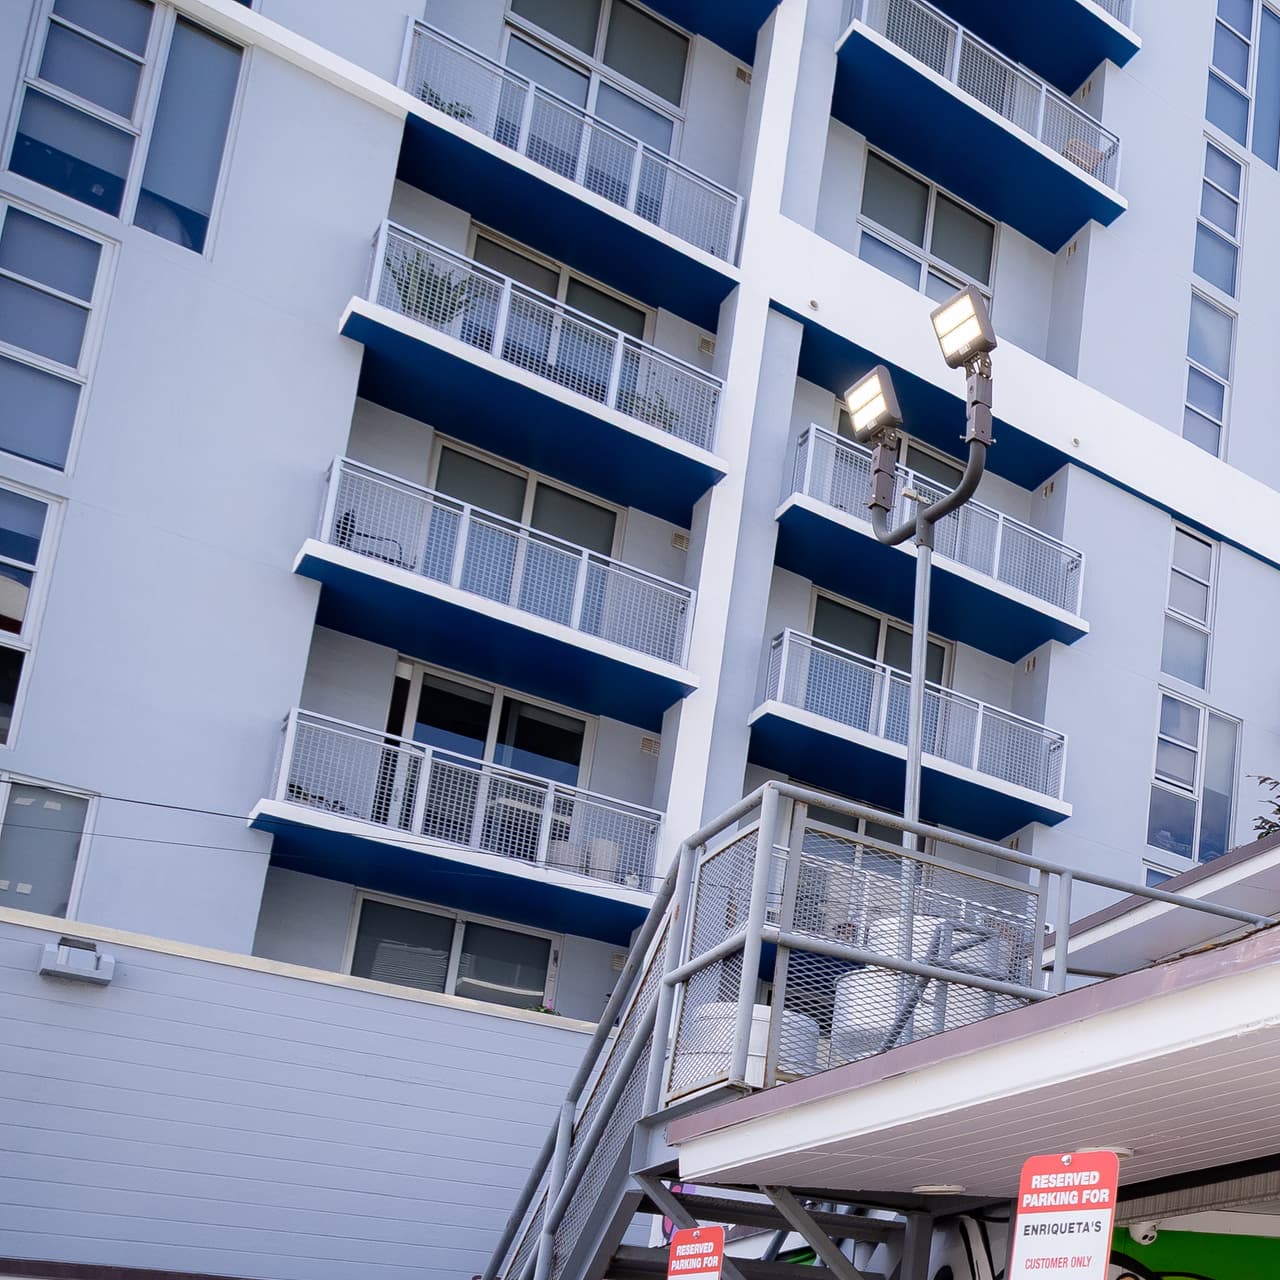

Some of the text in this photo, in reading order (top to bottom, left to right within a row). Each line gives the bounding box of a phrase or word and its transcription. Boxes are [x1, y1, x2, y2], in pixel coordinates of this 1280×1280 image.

[1032, 1171, 1100, 1188] RESERVED
[1023, 1189, 1110, 1208] PARKING FOR
[1023, 1220, 1102, 1236] ENRIQUETA'S
[676, 1242, 714, 1256] RESERVED
[671, 1256, 719, 1271] PARKING FOR
[1025, 1255, 1092, 1270] CUSTOMER ONLY
